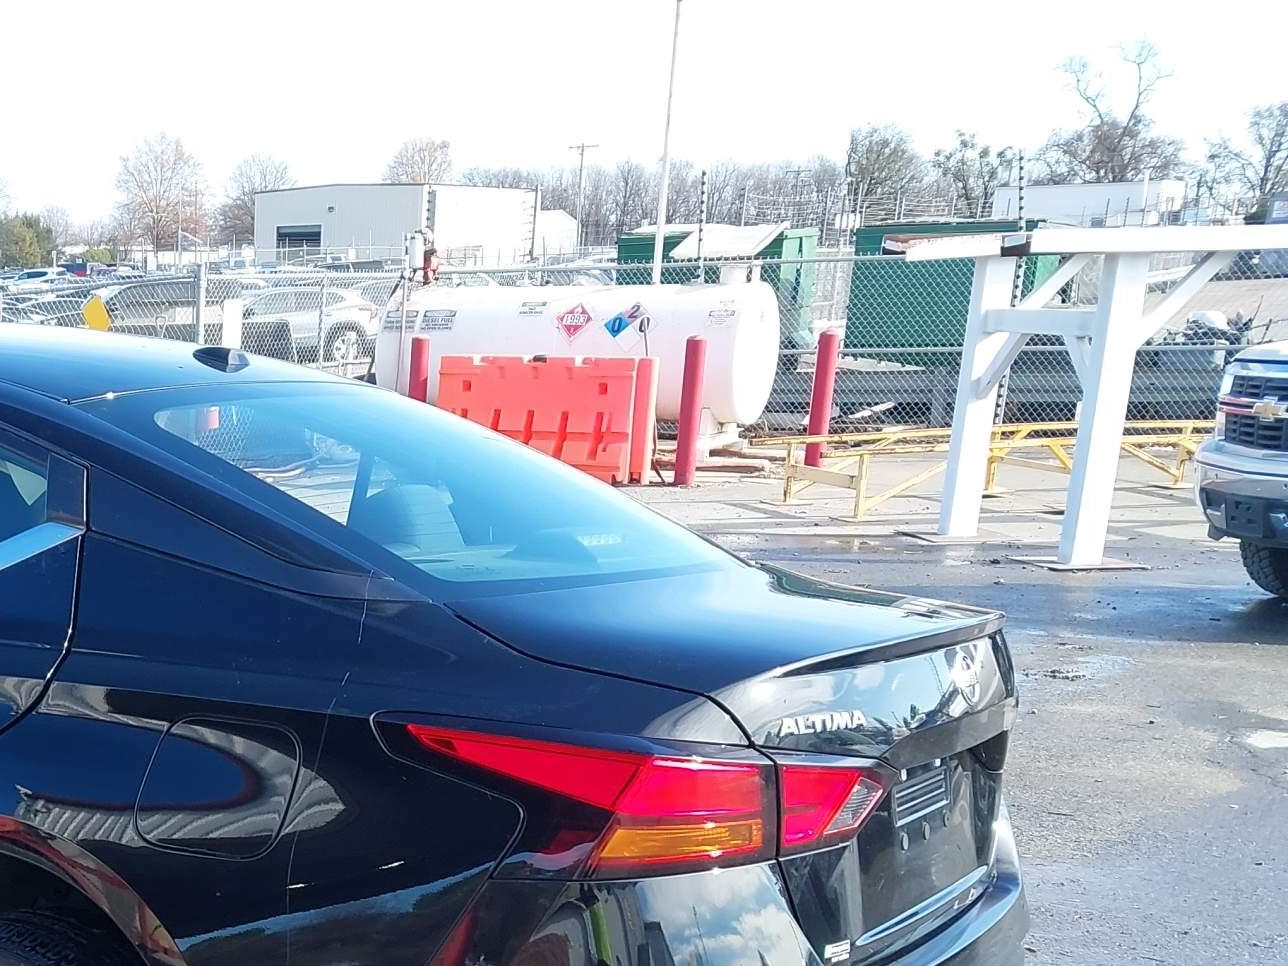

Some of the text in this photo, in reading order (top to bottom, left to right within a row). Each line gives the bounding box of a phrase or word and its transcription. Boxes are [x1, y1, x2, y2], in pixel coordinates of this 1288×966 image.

[627, 304, 641, 319] 2
[564, 314, 587, 325] 1993
[612, 317, 623, 333] 0
[778, 710, 867, 737] ALTIMA
